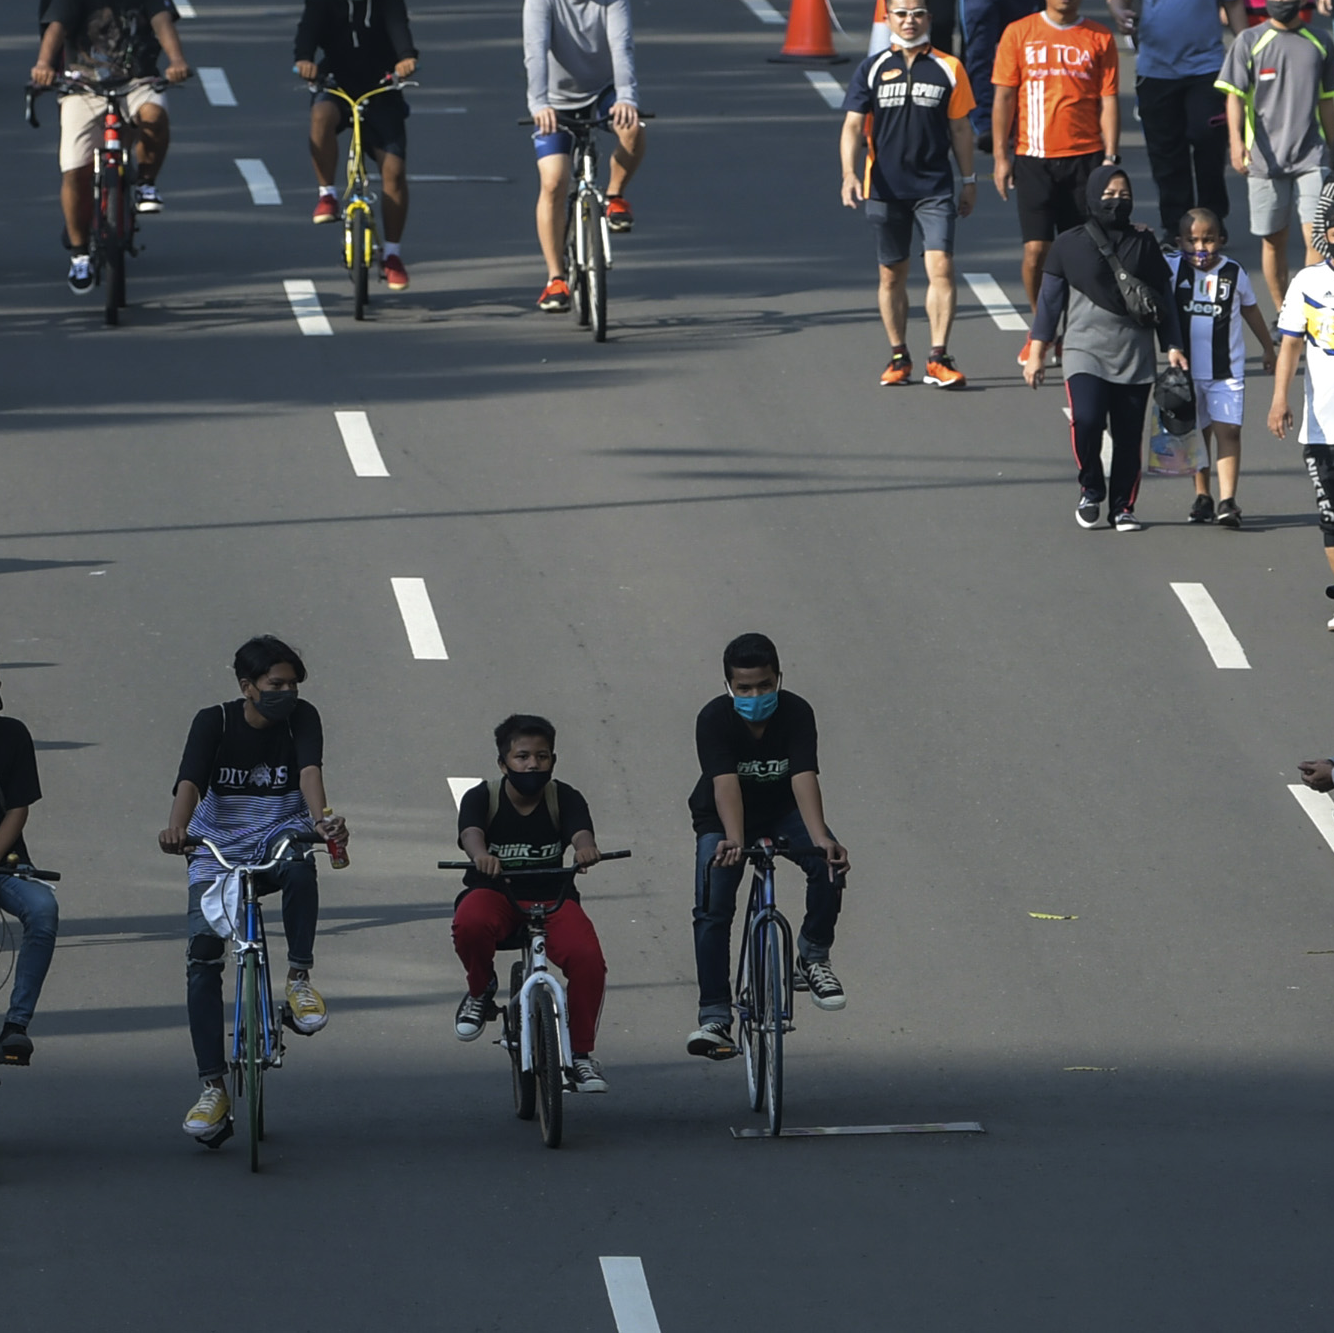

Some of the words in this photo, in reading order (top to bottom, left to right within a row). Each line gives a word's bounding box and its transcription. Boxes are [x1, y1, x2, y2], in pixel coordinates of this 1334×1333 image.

[1052, 43, 1093, 68] TOA
[877, 82, 907, 98] LOTTO
[911, 82, 946, 99] SPORT
[1183, 300, 1223, 317] Jeep
[1306, 454, 1326, 497] NIKE
